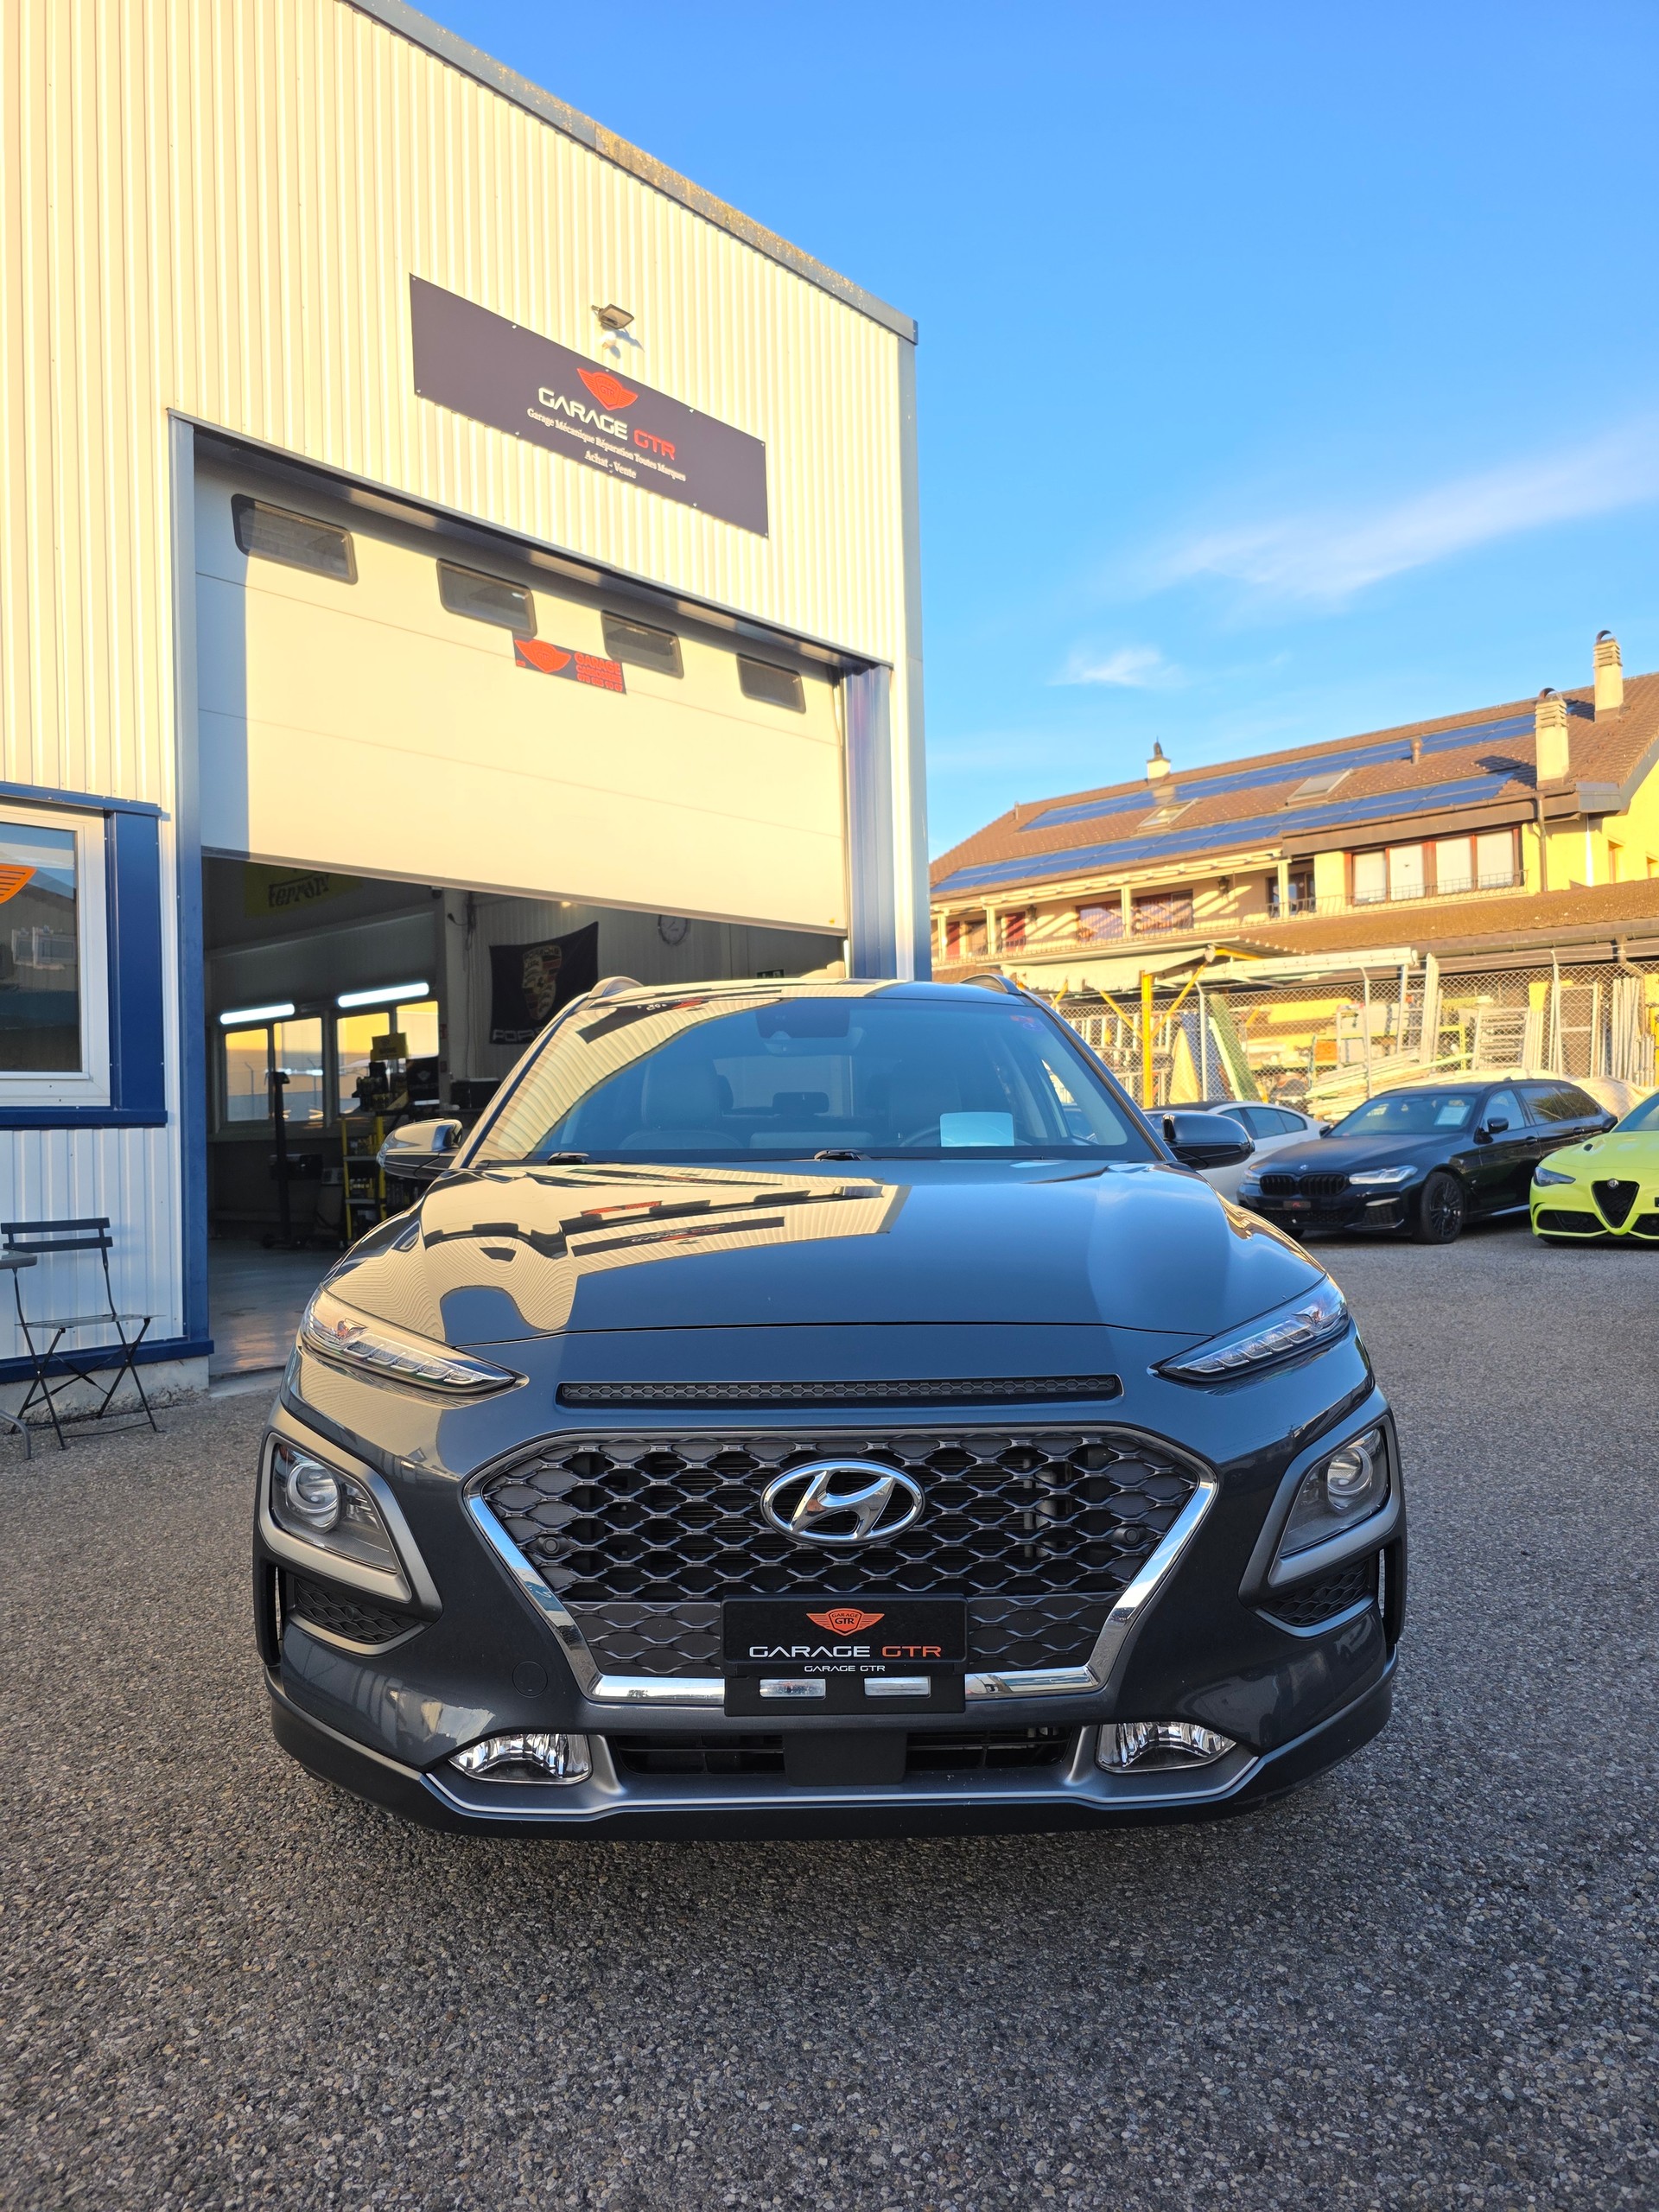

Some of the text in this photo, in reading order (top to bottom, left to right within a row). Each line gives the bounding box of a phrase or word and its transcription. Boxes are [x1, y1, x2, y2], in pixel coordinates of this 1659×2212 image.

[538, 387, 676, 461] GARAGE GTR
[526, 408, 687, 482] Garage Mécanique Réparation Toutes Marques
[584, 450, 609, 468] Achat
[613, 461, 637, 480] Vente
[575, 652, 621, 676] GARAGE
[268, 872, 331, 908] Ferrari
[749, 1645, 942, 1658] GARAGE GTR
